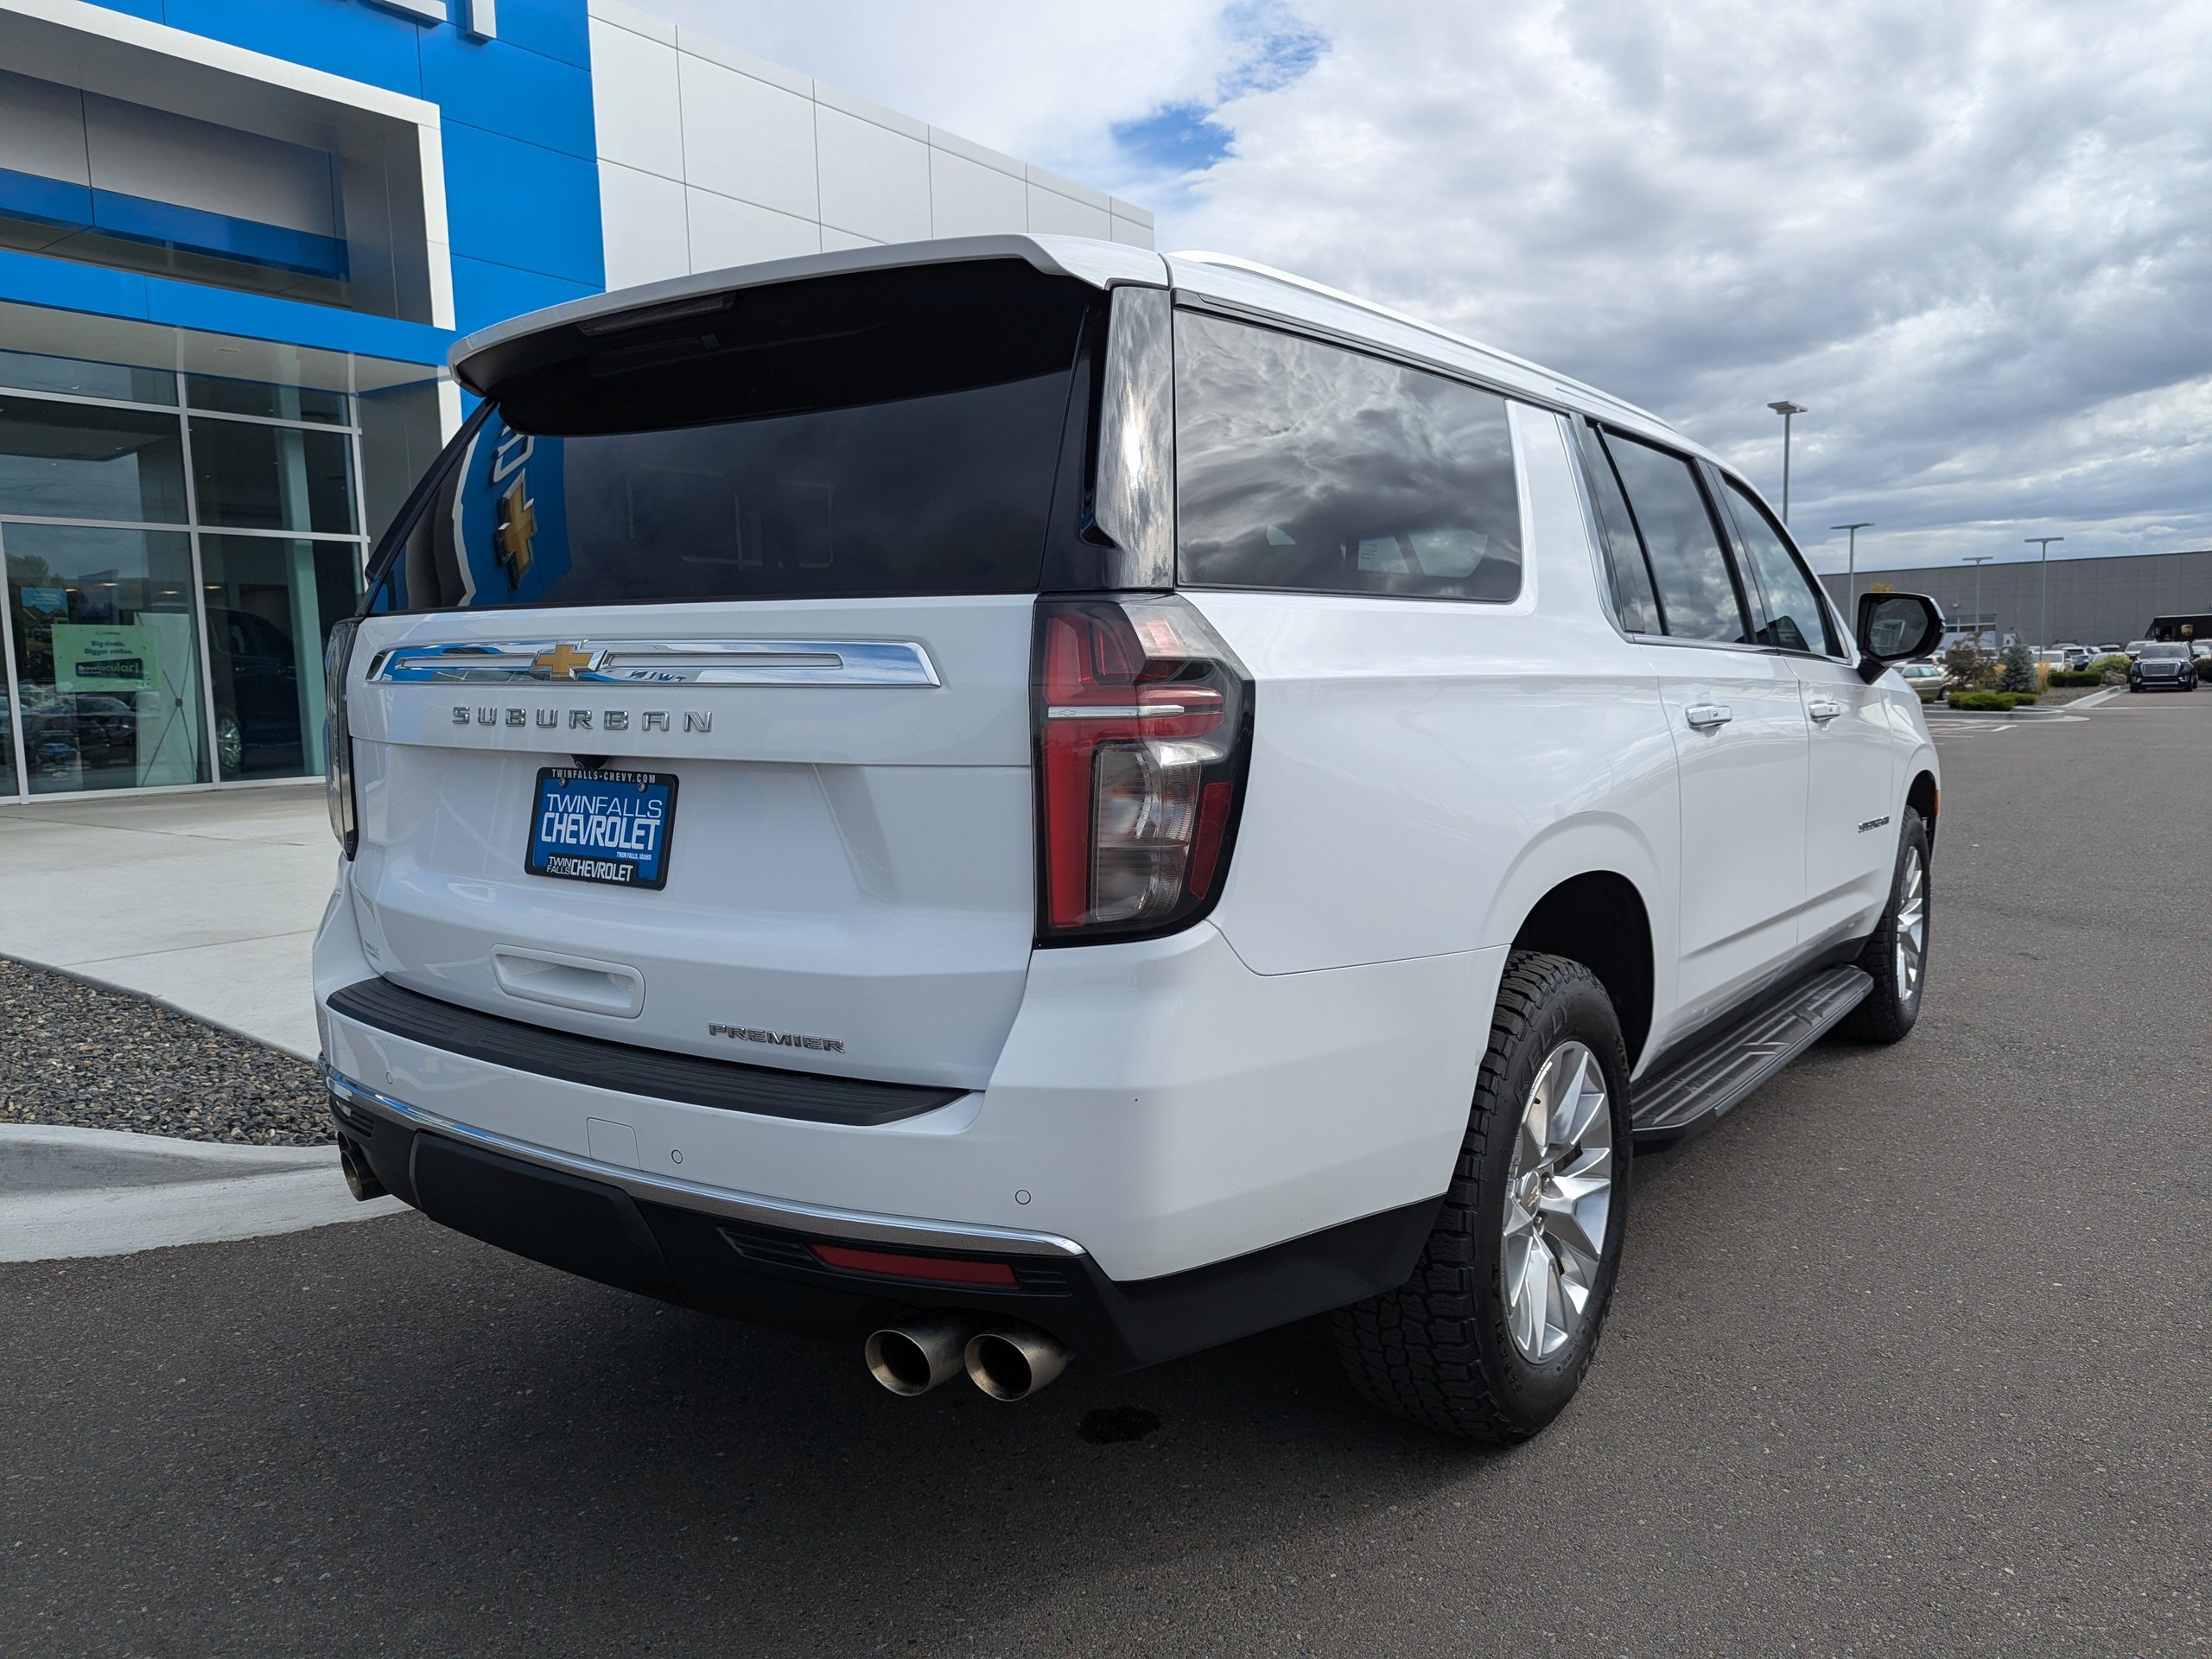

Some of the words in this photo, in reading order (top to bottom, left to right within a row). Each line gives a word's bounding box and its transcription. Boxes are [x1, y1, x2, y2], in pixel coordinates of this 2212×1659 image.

[452, 706, 713, 733] SUBURBAN
[552, 769, 656, 784] TWINFALLS-CHEVY.COM
[546, 793, 663, 818] TWINFALLS
[541, 812, 660, 850] CHEVROLET
[546, 865, 570, 875] FALLS
[548, 856, 571, 867] TWIN
[570, 859, 633, 881] CHEVROLET
[709, 1023, 846, 1053] PREMIER
